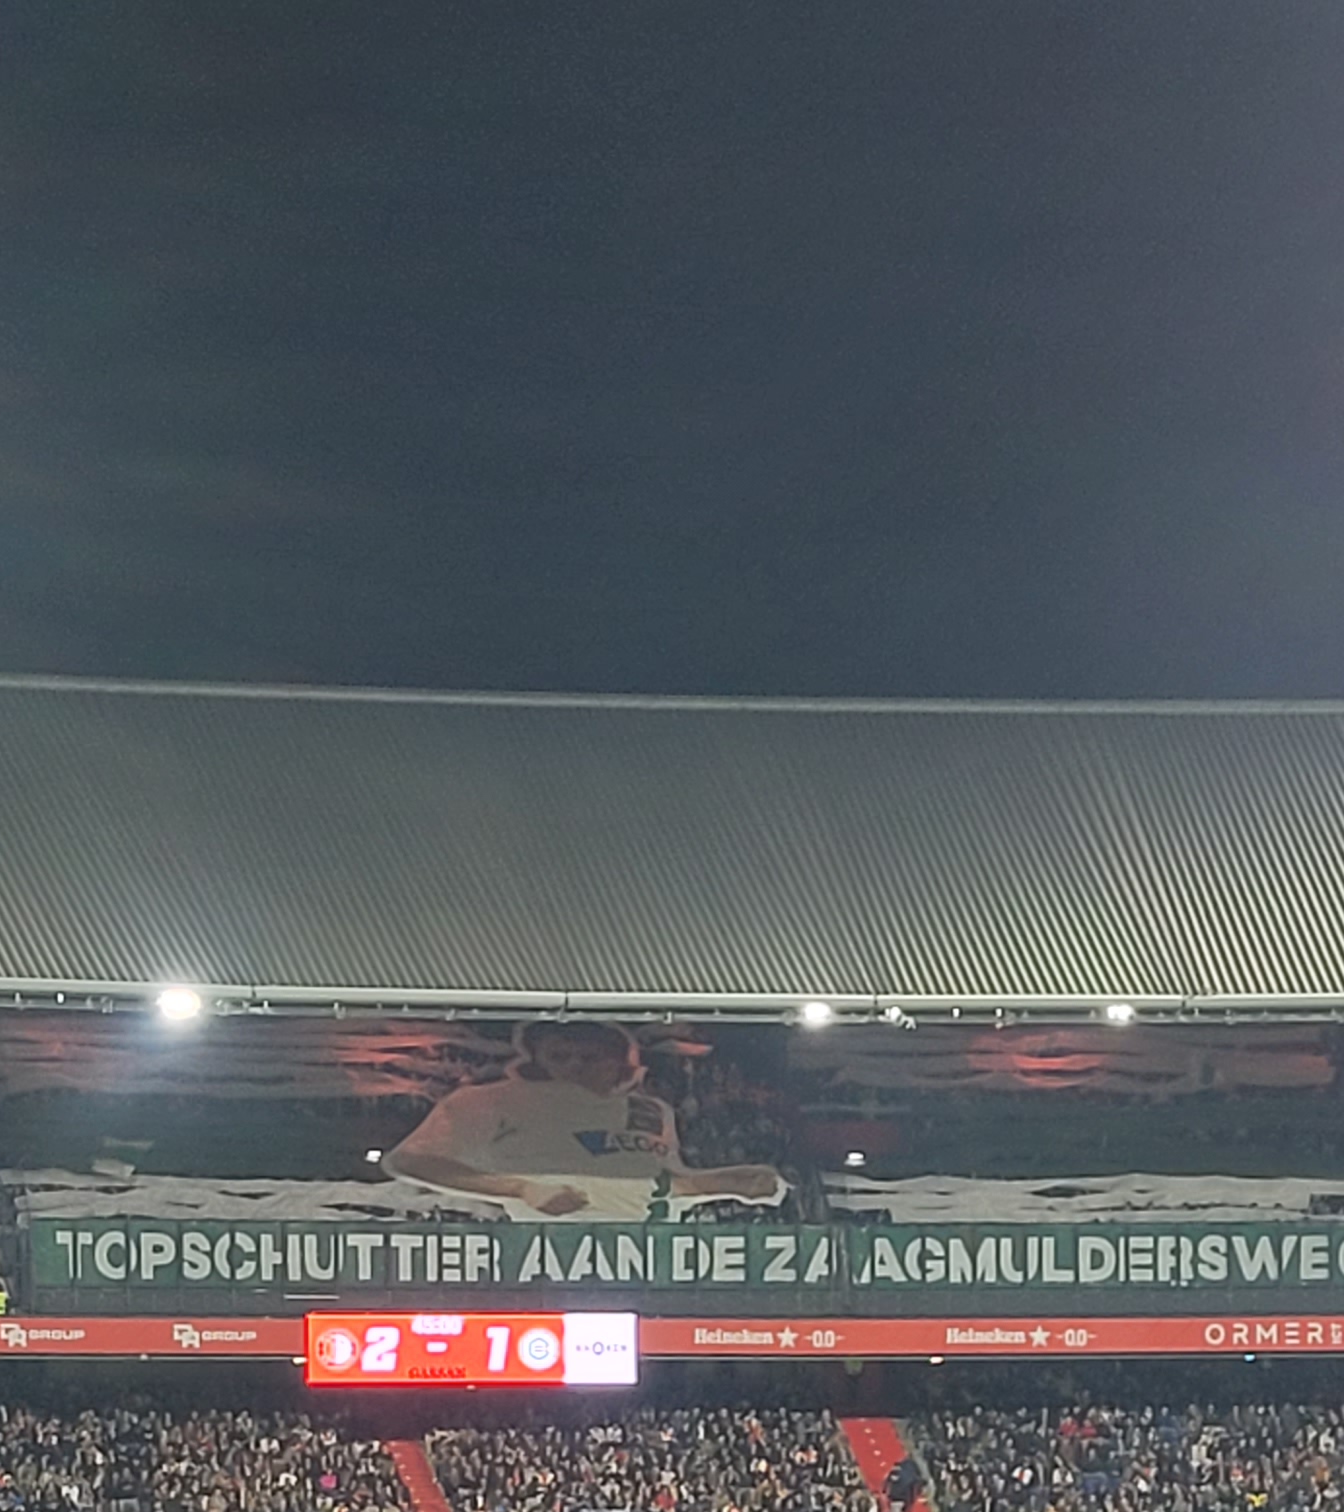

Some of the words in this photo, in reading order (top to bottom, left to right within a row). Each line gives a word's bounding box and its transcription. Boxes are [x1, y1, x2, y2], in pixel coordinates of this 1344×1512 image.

[56, 1231, 501, 1282] TOPSCHUTTER
[518, 1235, 654, 1283] AAN
[671, 1236, 746, 1282] DE
[28, 1328, 85, 1341] GROUP
[202, 1331, 256, 1342] GROUP
[694, 1328, 774, 1345] Heineken
[946, 1327, 1026, 1345] Heineken
[1204, 1322, 1324, 1345] ORMER
[361, 1326, 400, 1372] 2
[486, 1326, 509, 1372] 1
